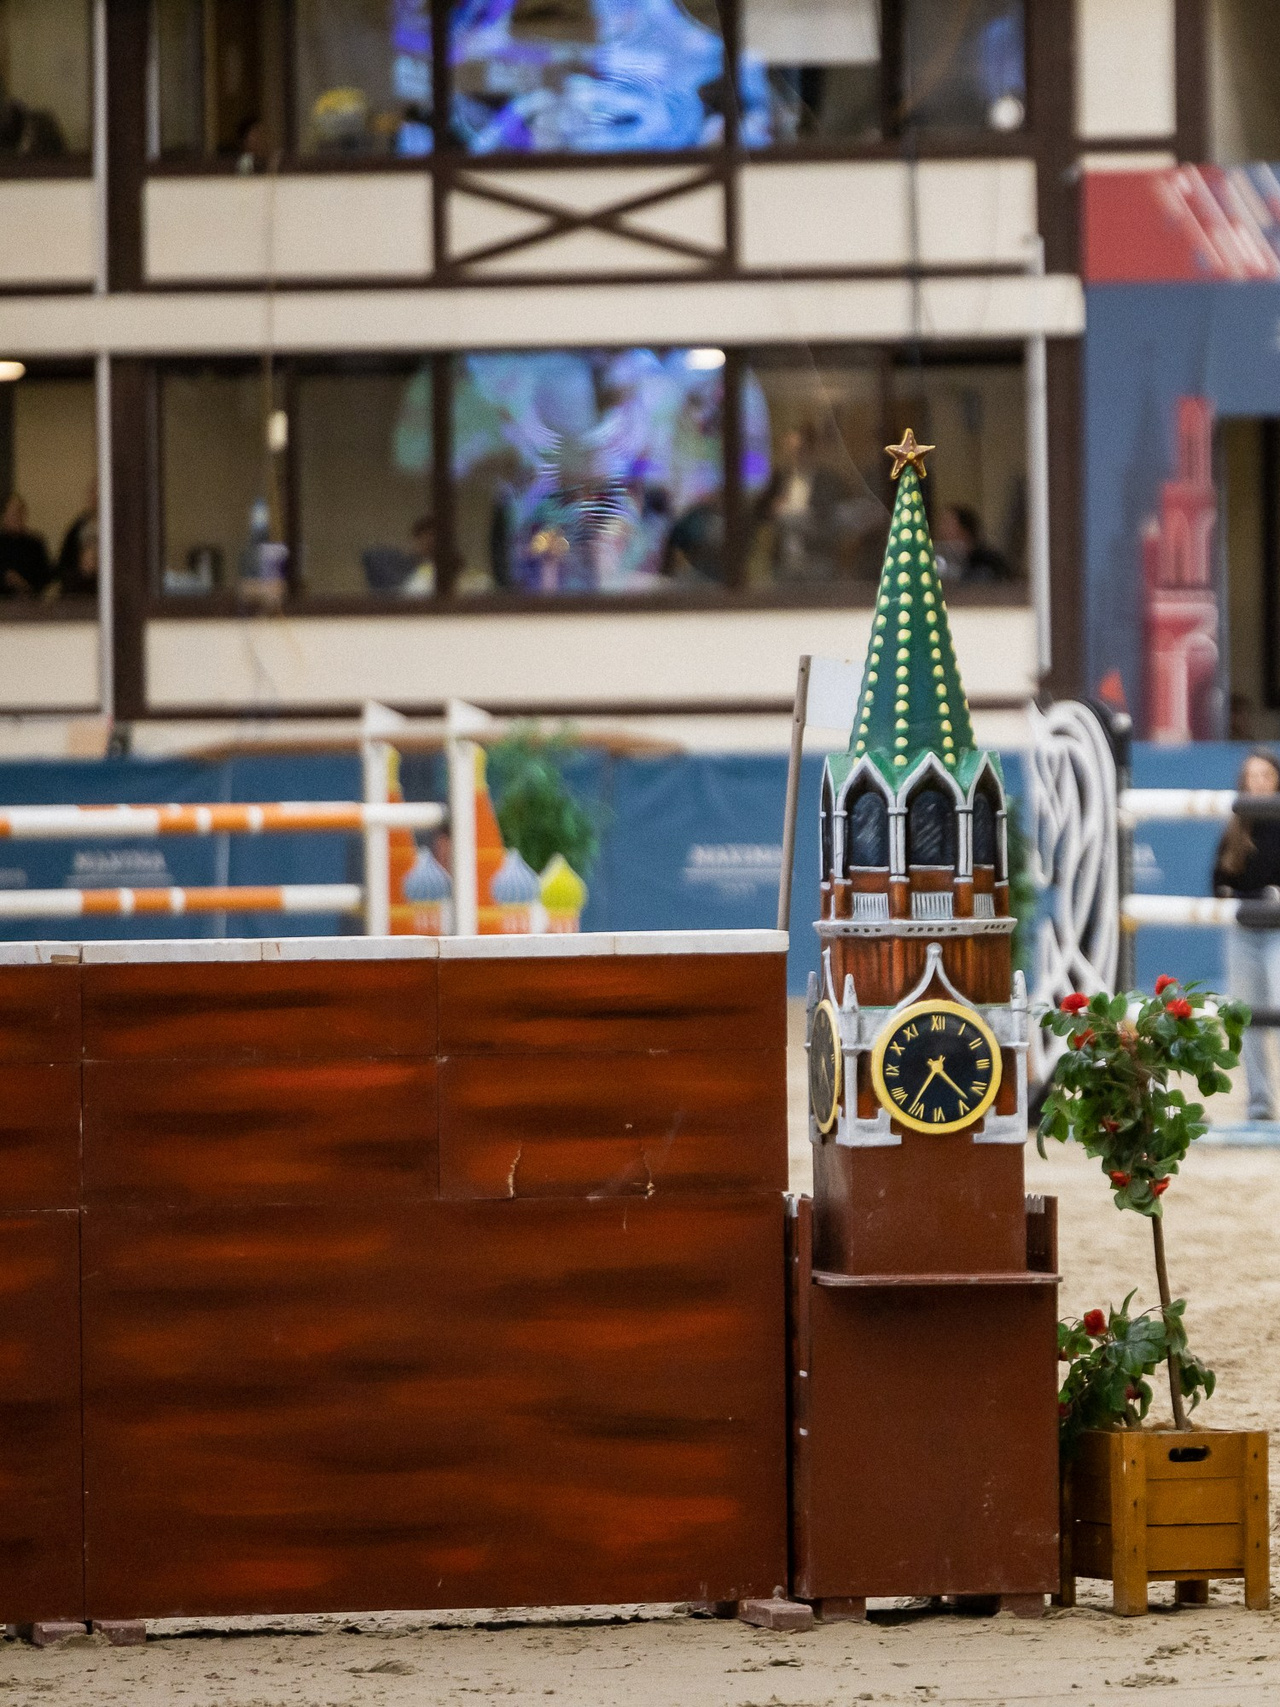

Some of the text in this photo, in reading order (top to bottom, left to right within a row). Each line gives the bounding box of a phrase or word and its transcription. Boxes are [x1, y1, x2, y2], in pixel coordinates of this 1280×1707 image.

[931, 1015, 945, 1031] XII
[903, 1023, 919, 1041] XI
[889, 1041, 905, 1056] X
[886, 1064, 900, 1076] IX
[976, 1058, 990, 1070] III
[934, 1106, 946, 1122] VI
[959, 1099, 970, 1116] V
